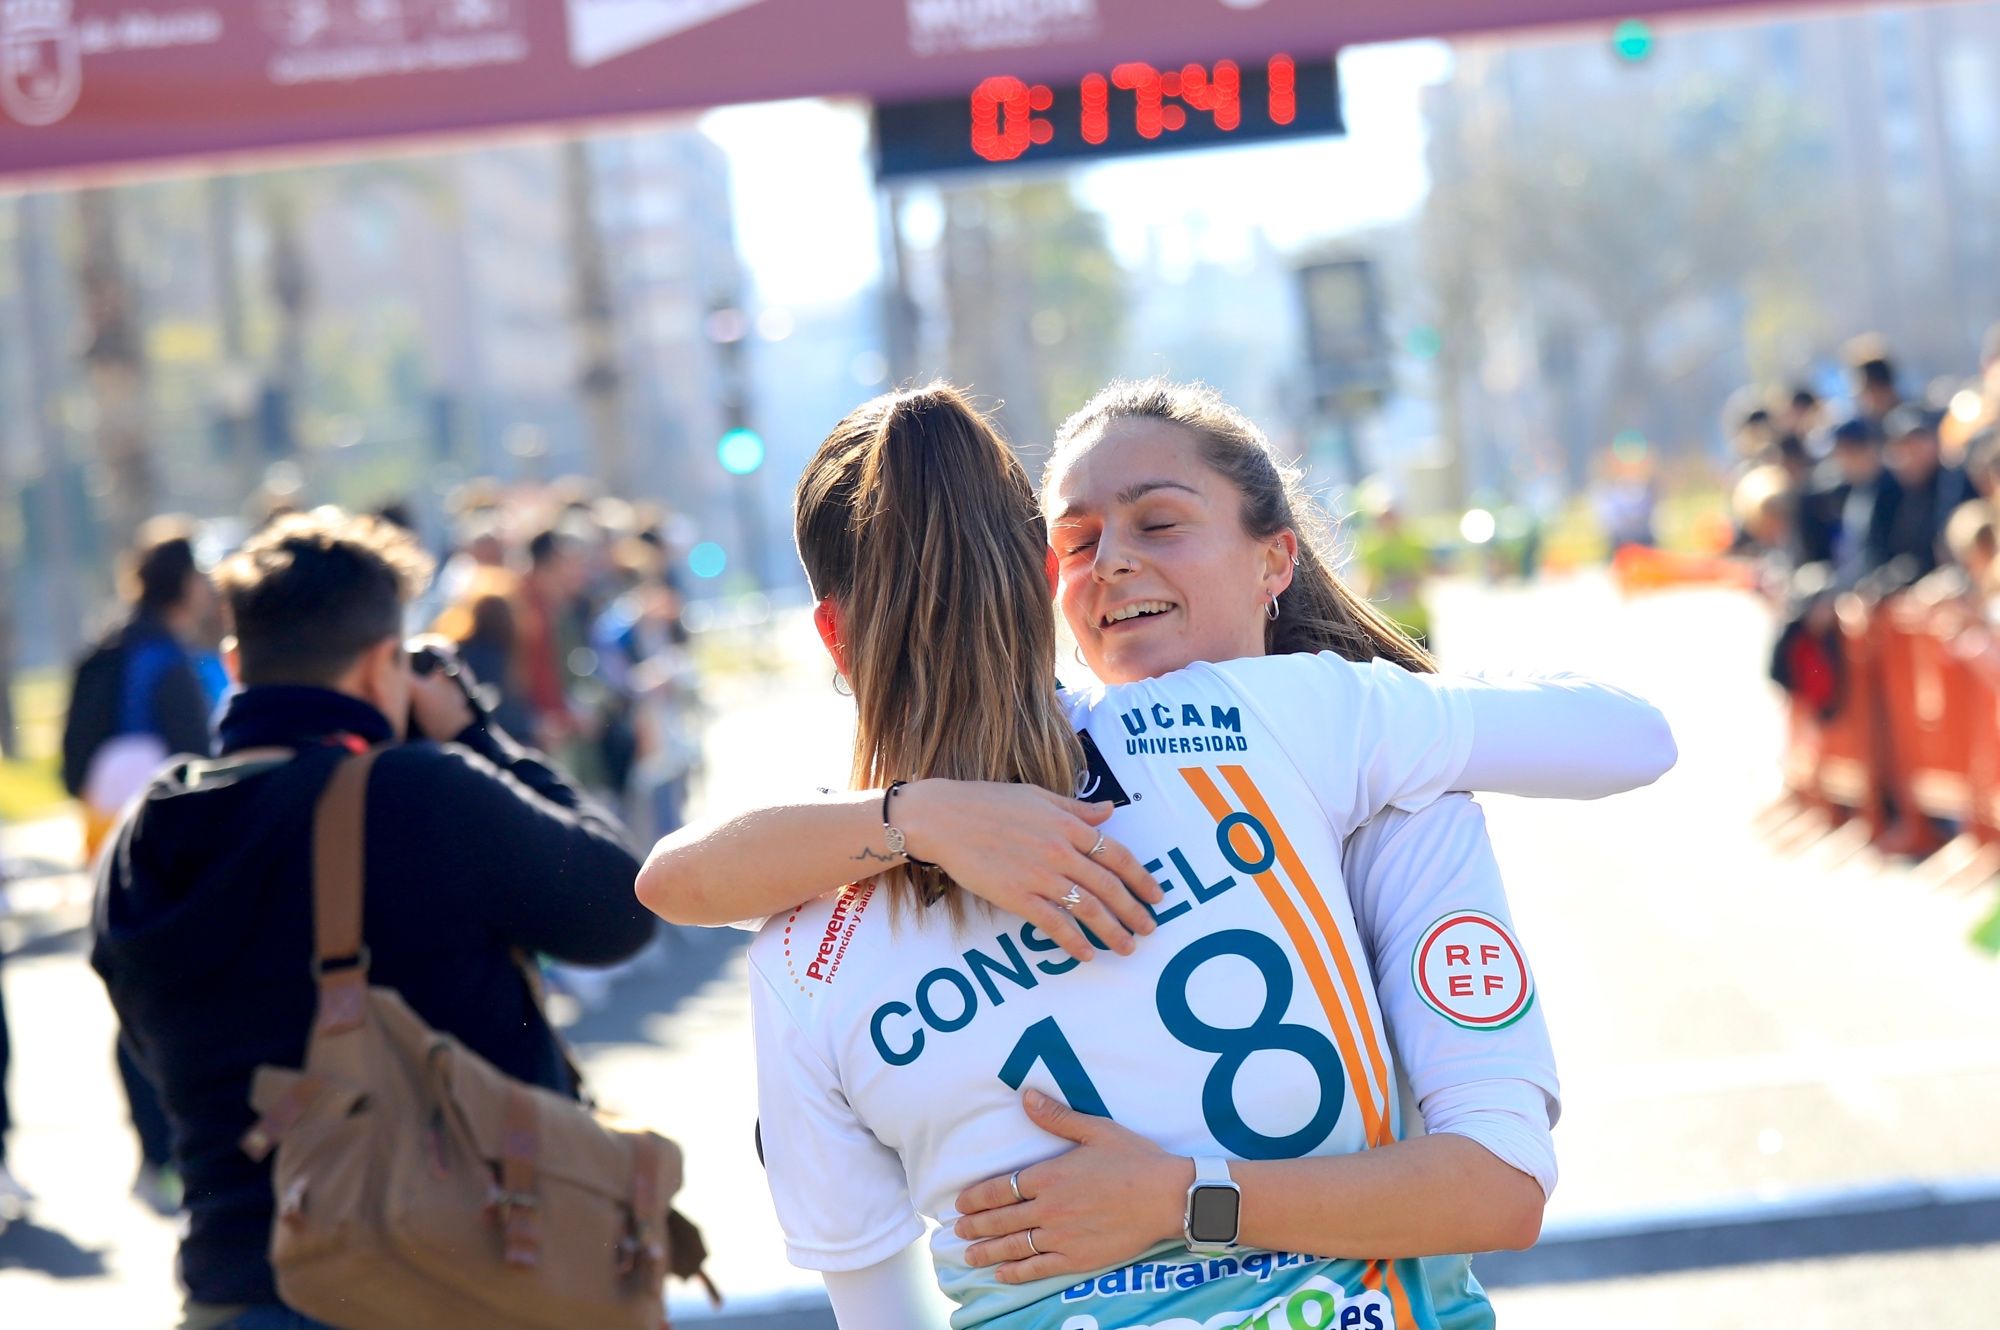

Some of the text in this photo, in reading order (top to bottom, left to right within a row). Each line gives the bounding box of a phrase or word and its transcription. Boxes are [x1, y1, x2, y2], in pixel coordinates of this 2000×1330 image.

[971, 54, 1296, 161] 0:17:41
[1120, 702, 1242, 737] UCAM
[1126, 735, 1248, 755] UNIVERSIDAD
[825, 924, 857, 985] Prevención
[852, 913, 862, 923] y
[998, 928, 1345, 1161] 18
